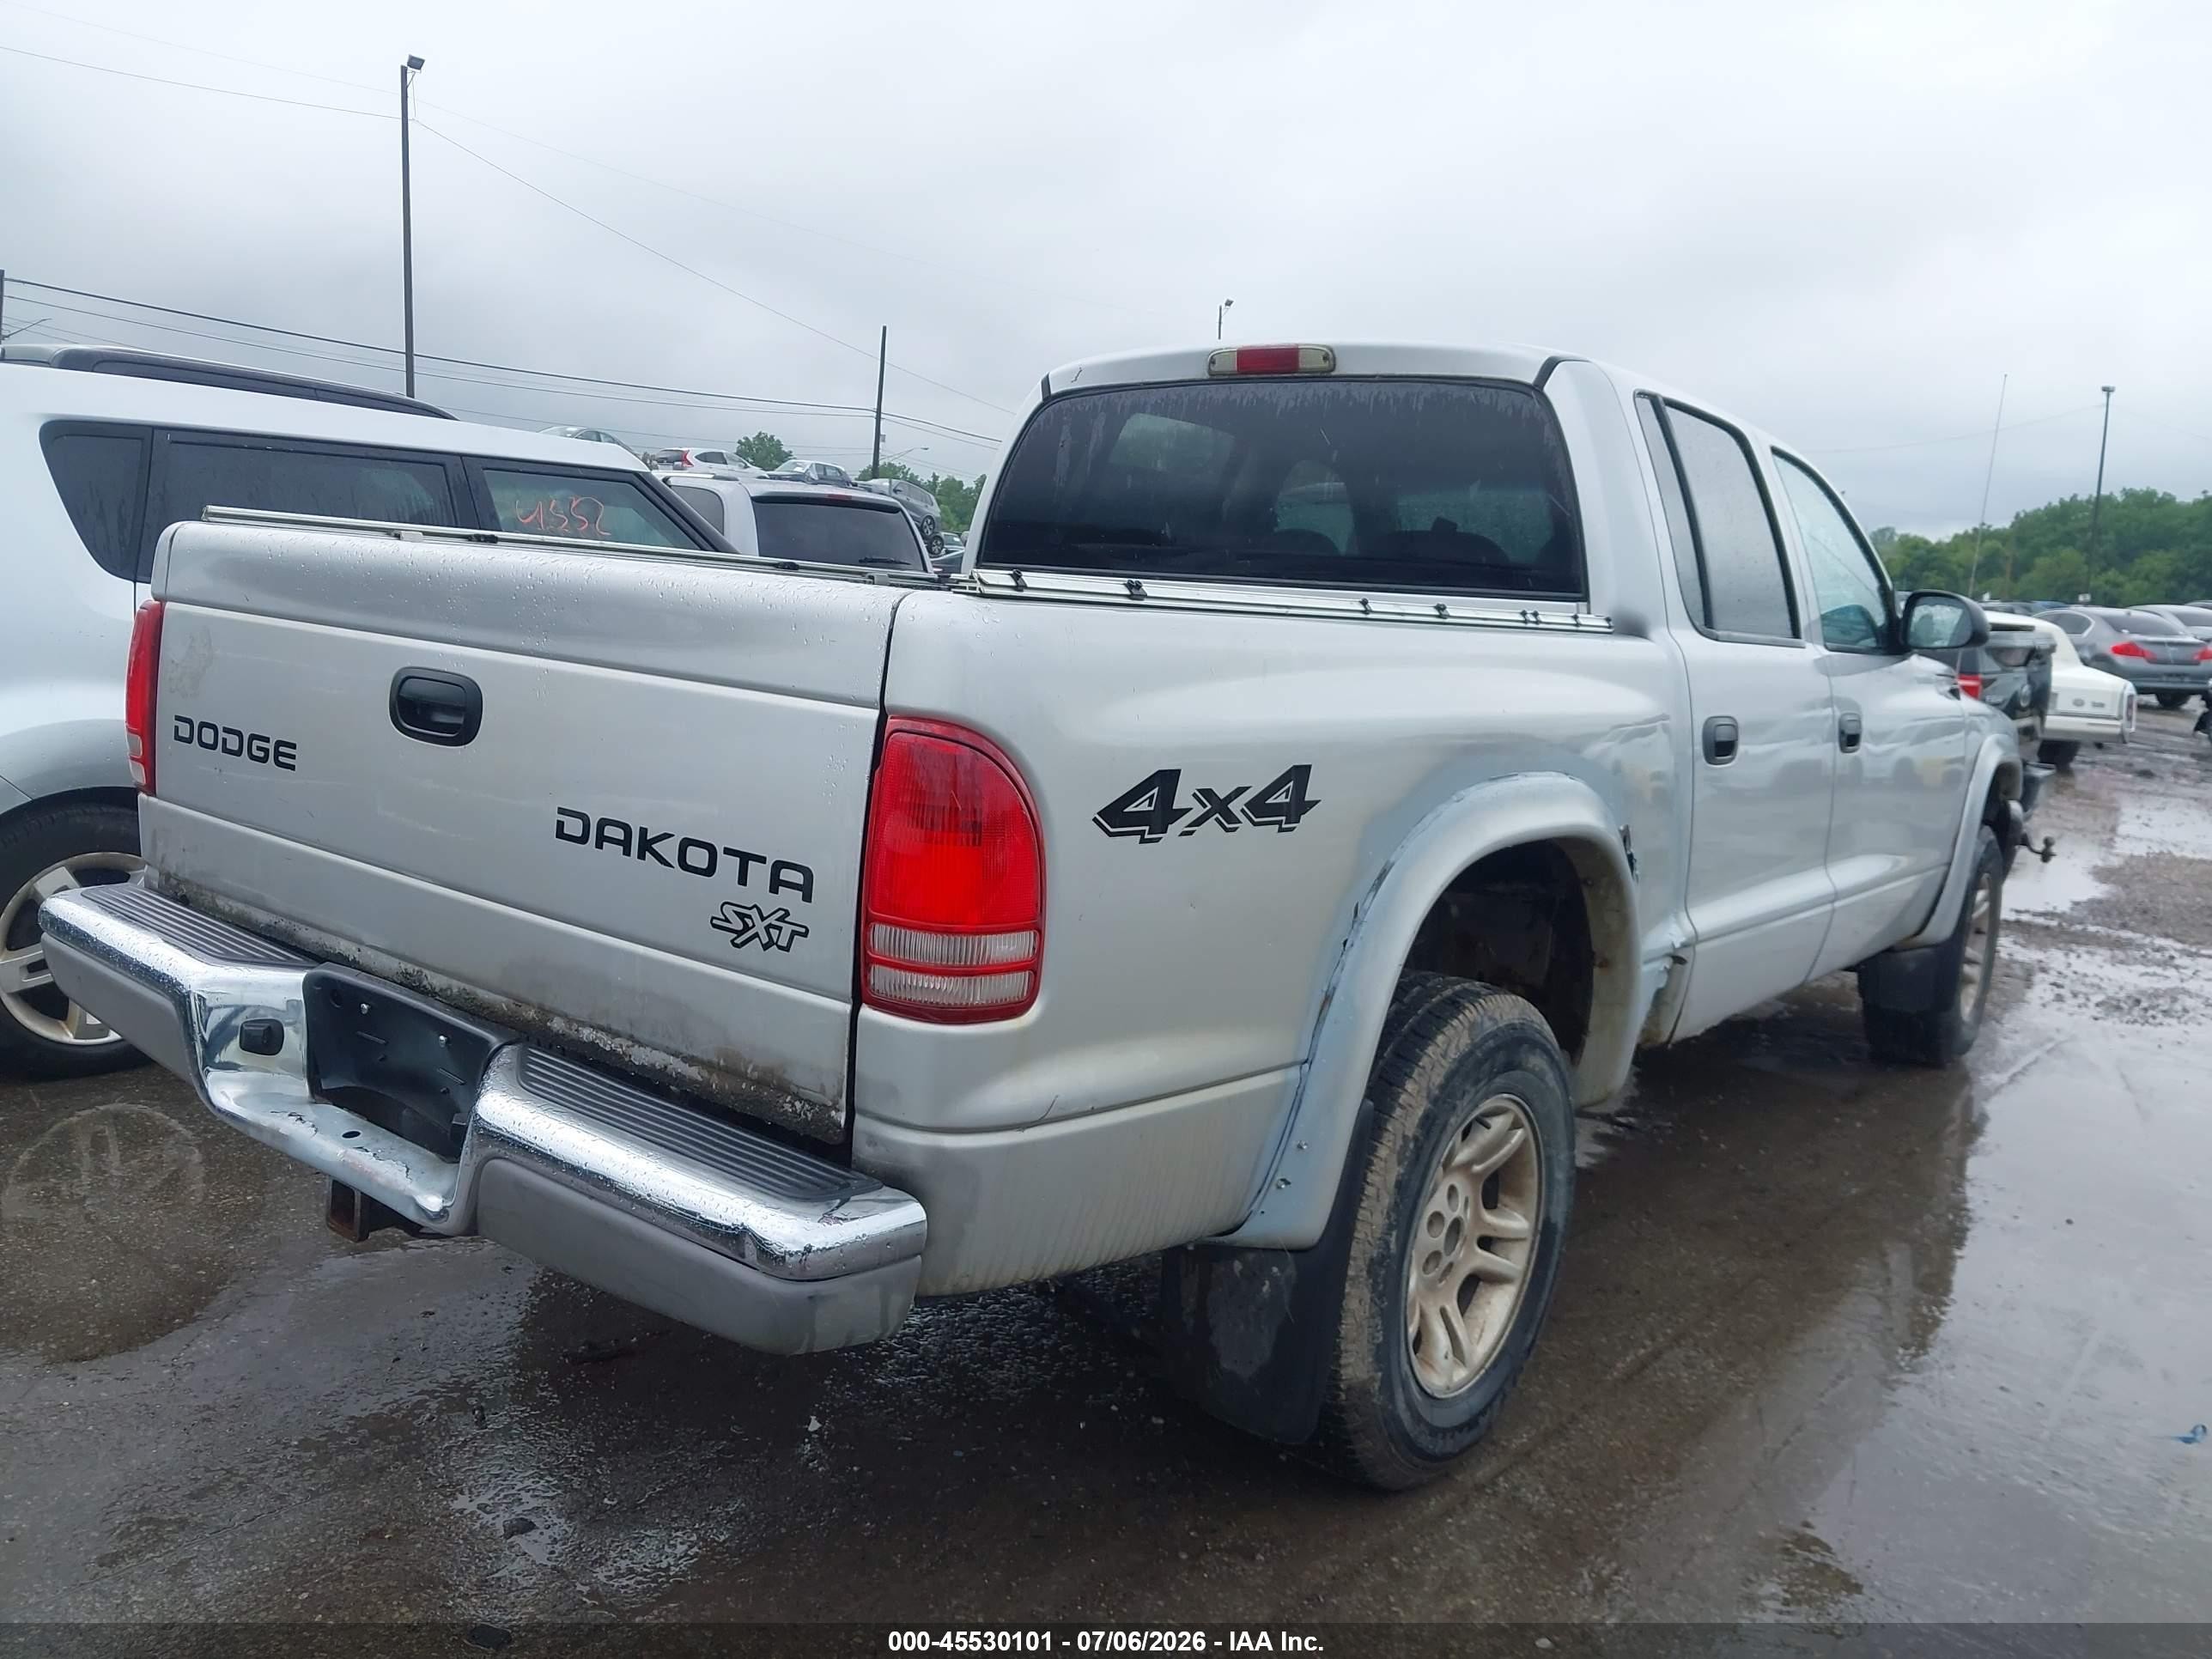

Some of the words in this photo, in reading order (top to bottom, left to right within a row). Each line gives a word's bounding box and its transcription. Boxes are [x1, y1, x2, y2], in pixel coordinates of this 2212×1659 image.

[173, 714, 297, 772] DODGE
[1091, 763, 1322, 845] 4x4
[555, 806, 814, 904] DAKOTA
[709, 901, 810, 953] SXT
